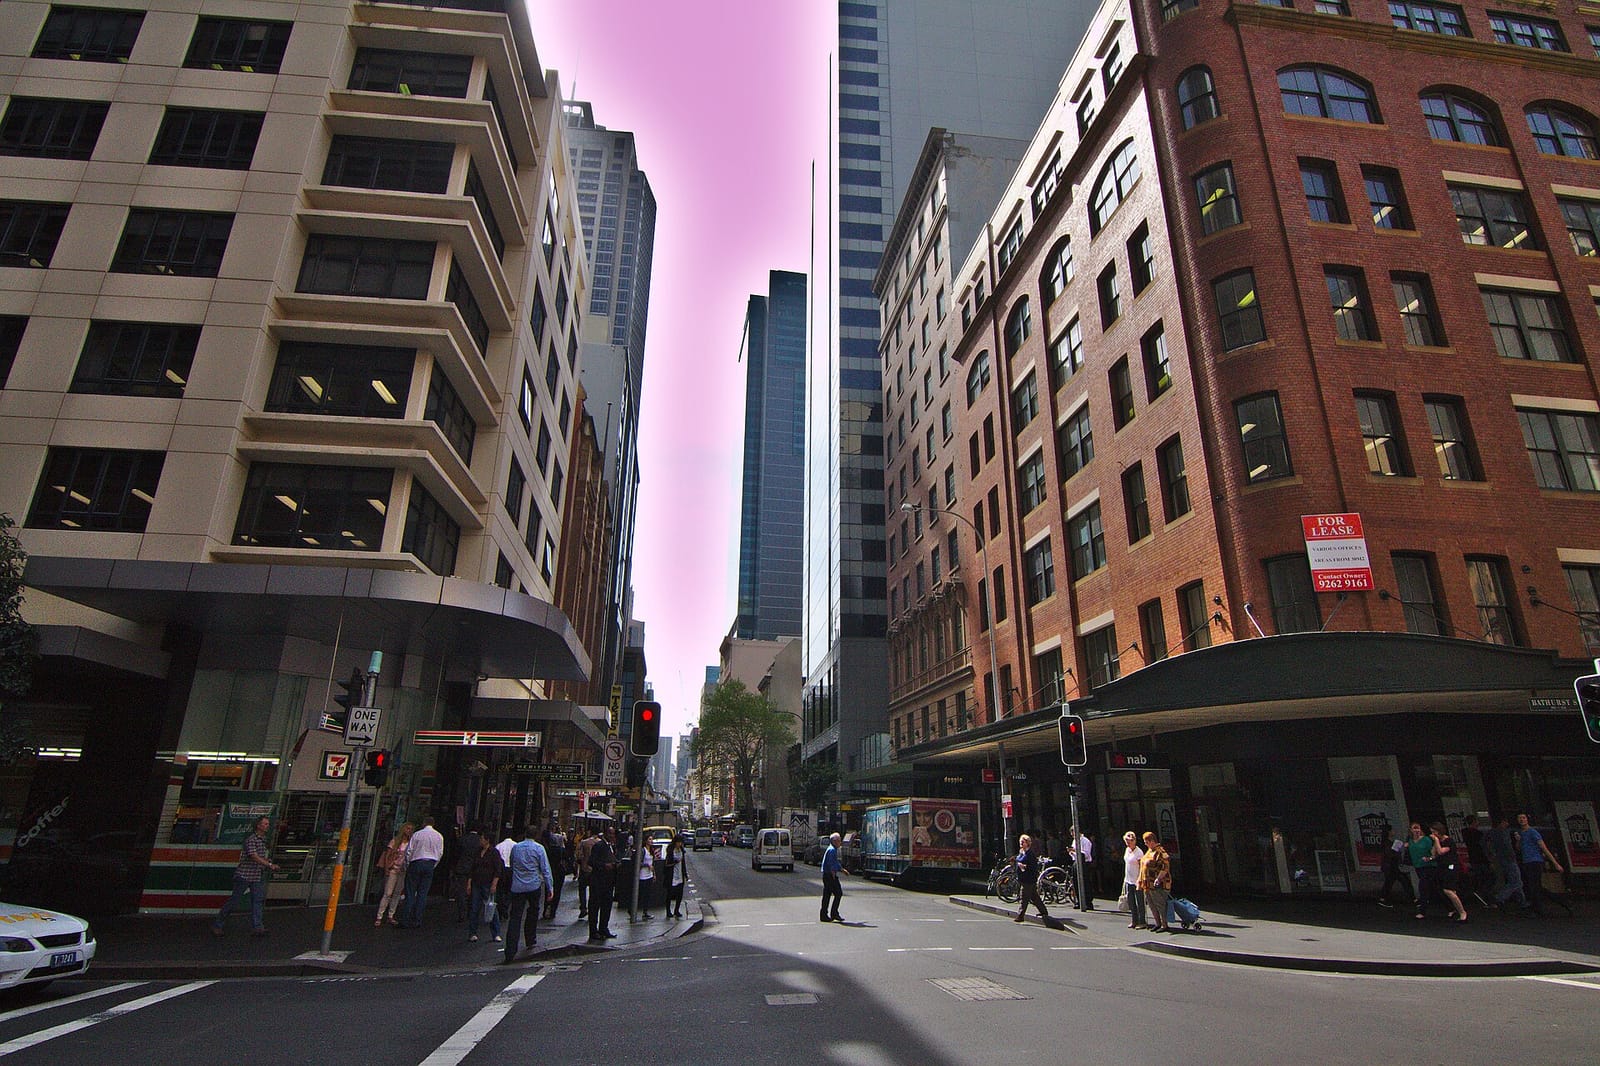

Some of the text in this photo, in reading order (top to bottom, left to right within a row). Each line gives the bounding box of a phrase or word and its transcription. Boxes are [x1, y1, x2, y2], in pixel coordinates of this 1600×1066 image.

[1318, 516, 1345, 526] FOR
[1312, 526, 1355, 536] LEASE
[1318, 579, 1368, 588] 9262 9161
[354, 710, 377, 721] ONE
[350, 722, 376, 733] WAY
[1127, 754, 1148, 765] nab
[607, 762, 621, 770] NO
